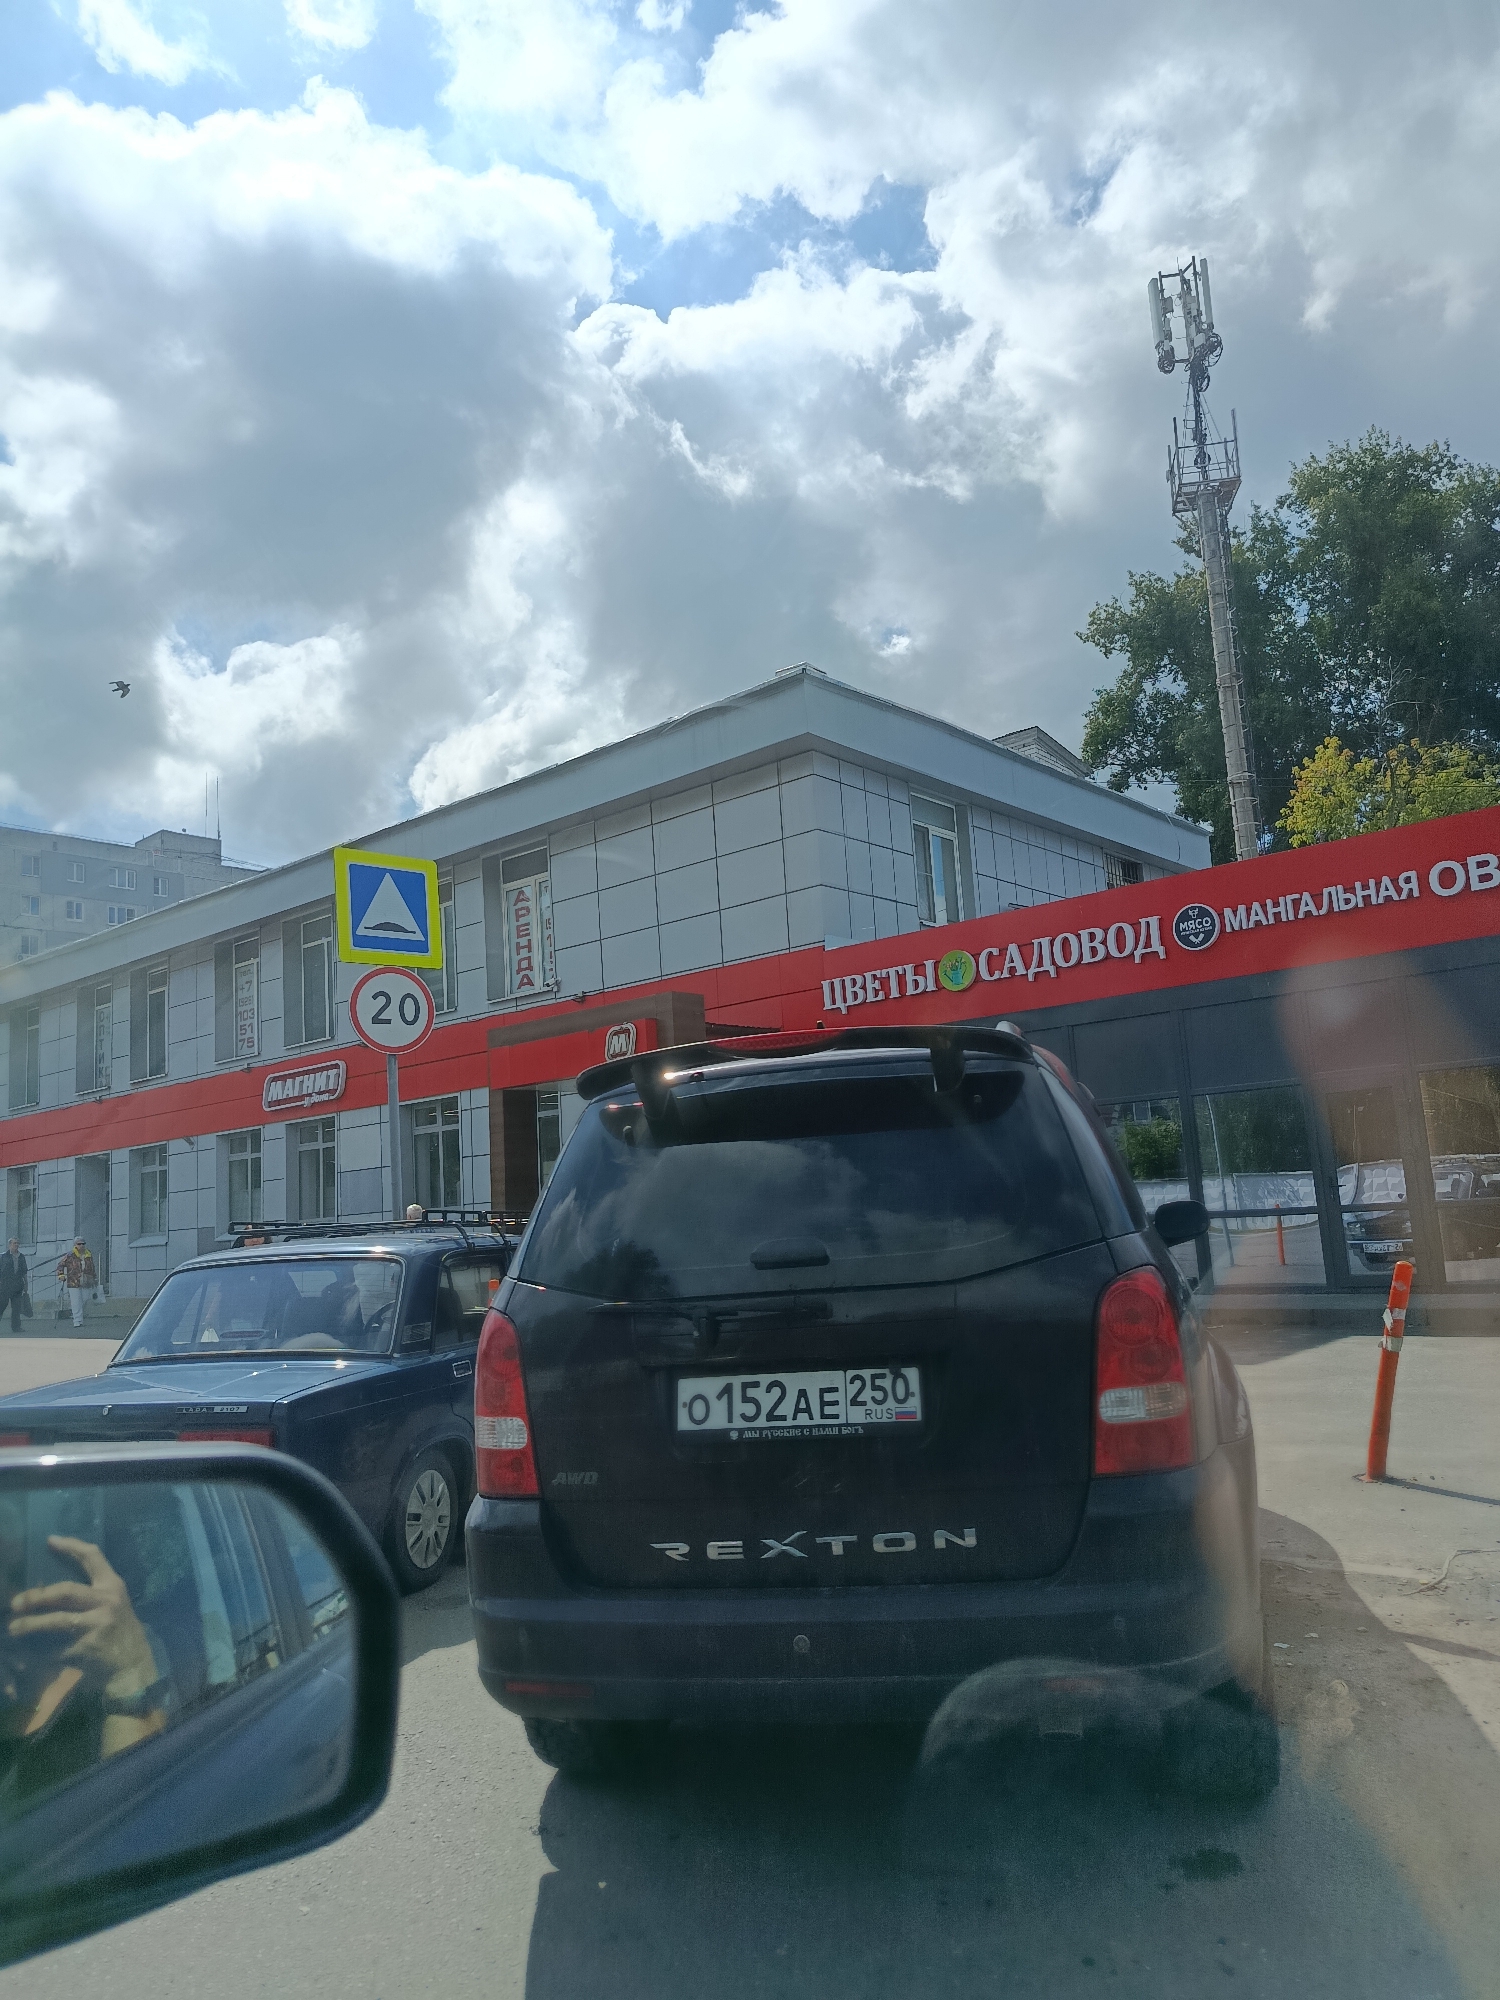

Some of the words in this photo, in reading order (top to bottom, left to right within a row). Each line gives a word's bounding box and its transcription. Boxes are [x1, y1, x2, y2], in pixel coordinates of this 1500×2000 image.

[1429, 853, 1500, 896] ОВ
[1223, 869, 1420, 933] МАНГАЛЬНАЯ
[513, 889, 535, 990] АРЕНДА
[1180, 917, 1211, 931] МЯСО
[821, 959, 938, 1014] ЦВЕТЫ
[978, 915, 1166, 981] САДОВОД
[238, 1007, 255, 1022] 103
[371, 990, 421, 1026] 20
[239, 1022, 254, 1036] 51
[239, 1036, 255, 1050] 75
[267, 1068, 340, 1102] МАГНИТ
[849, 1372, 910, 1407] 250
[864, 1407, 894, 1421] RUS
[743, 1429, 760, 1438] МЫ
[551, 1471, 600, 1486] AWD
[650, 1528, 977, 1561] REXTON
